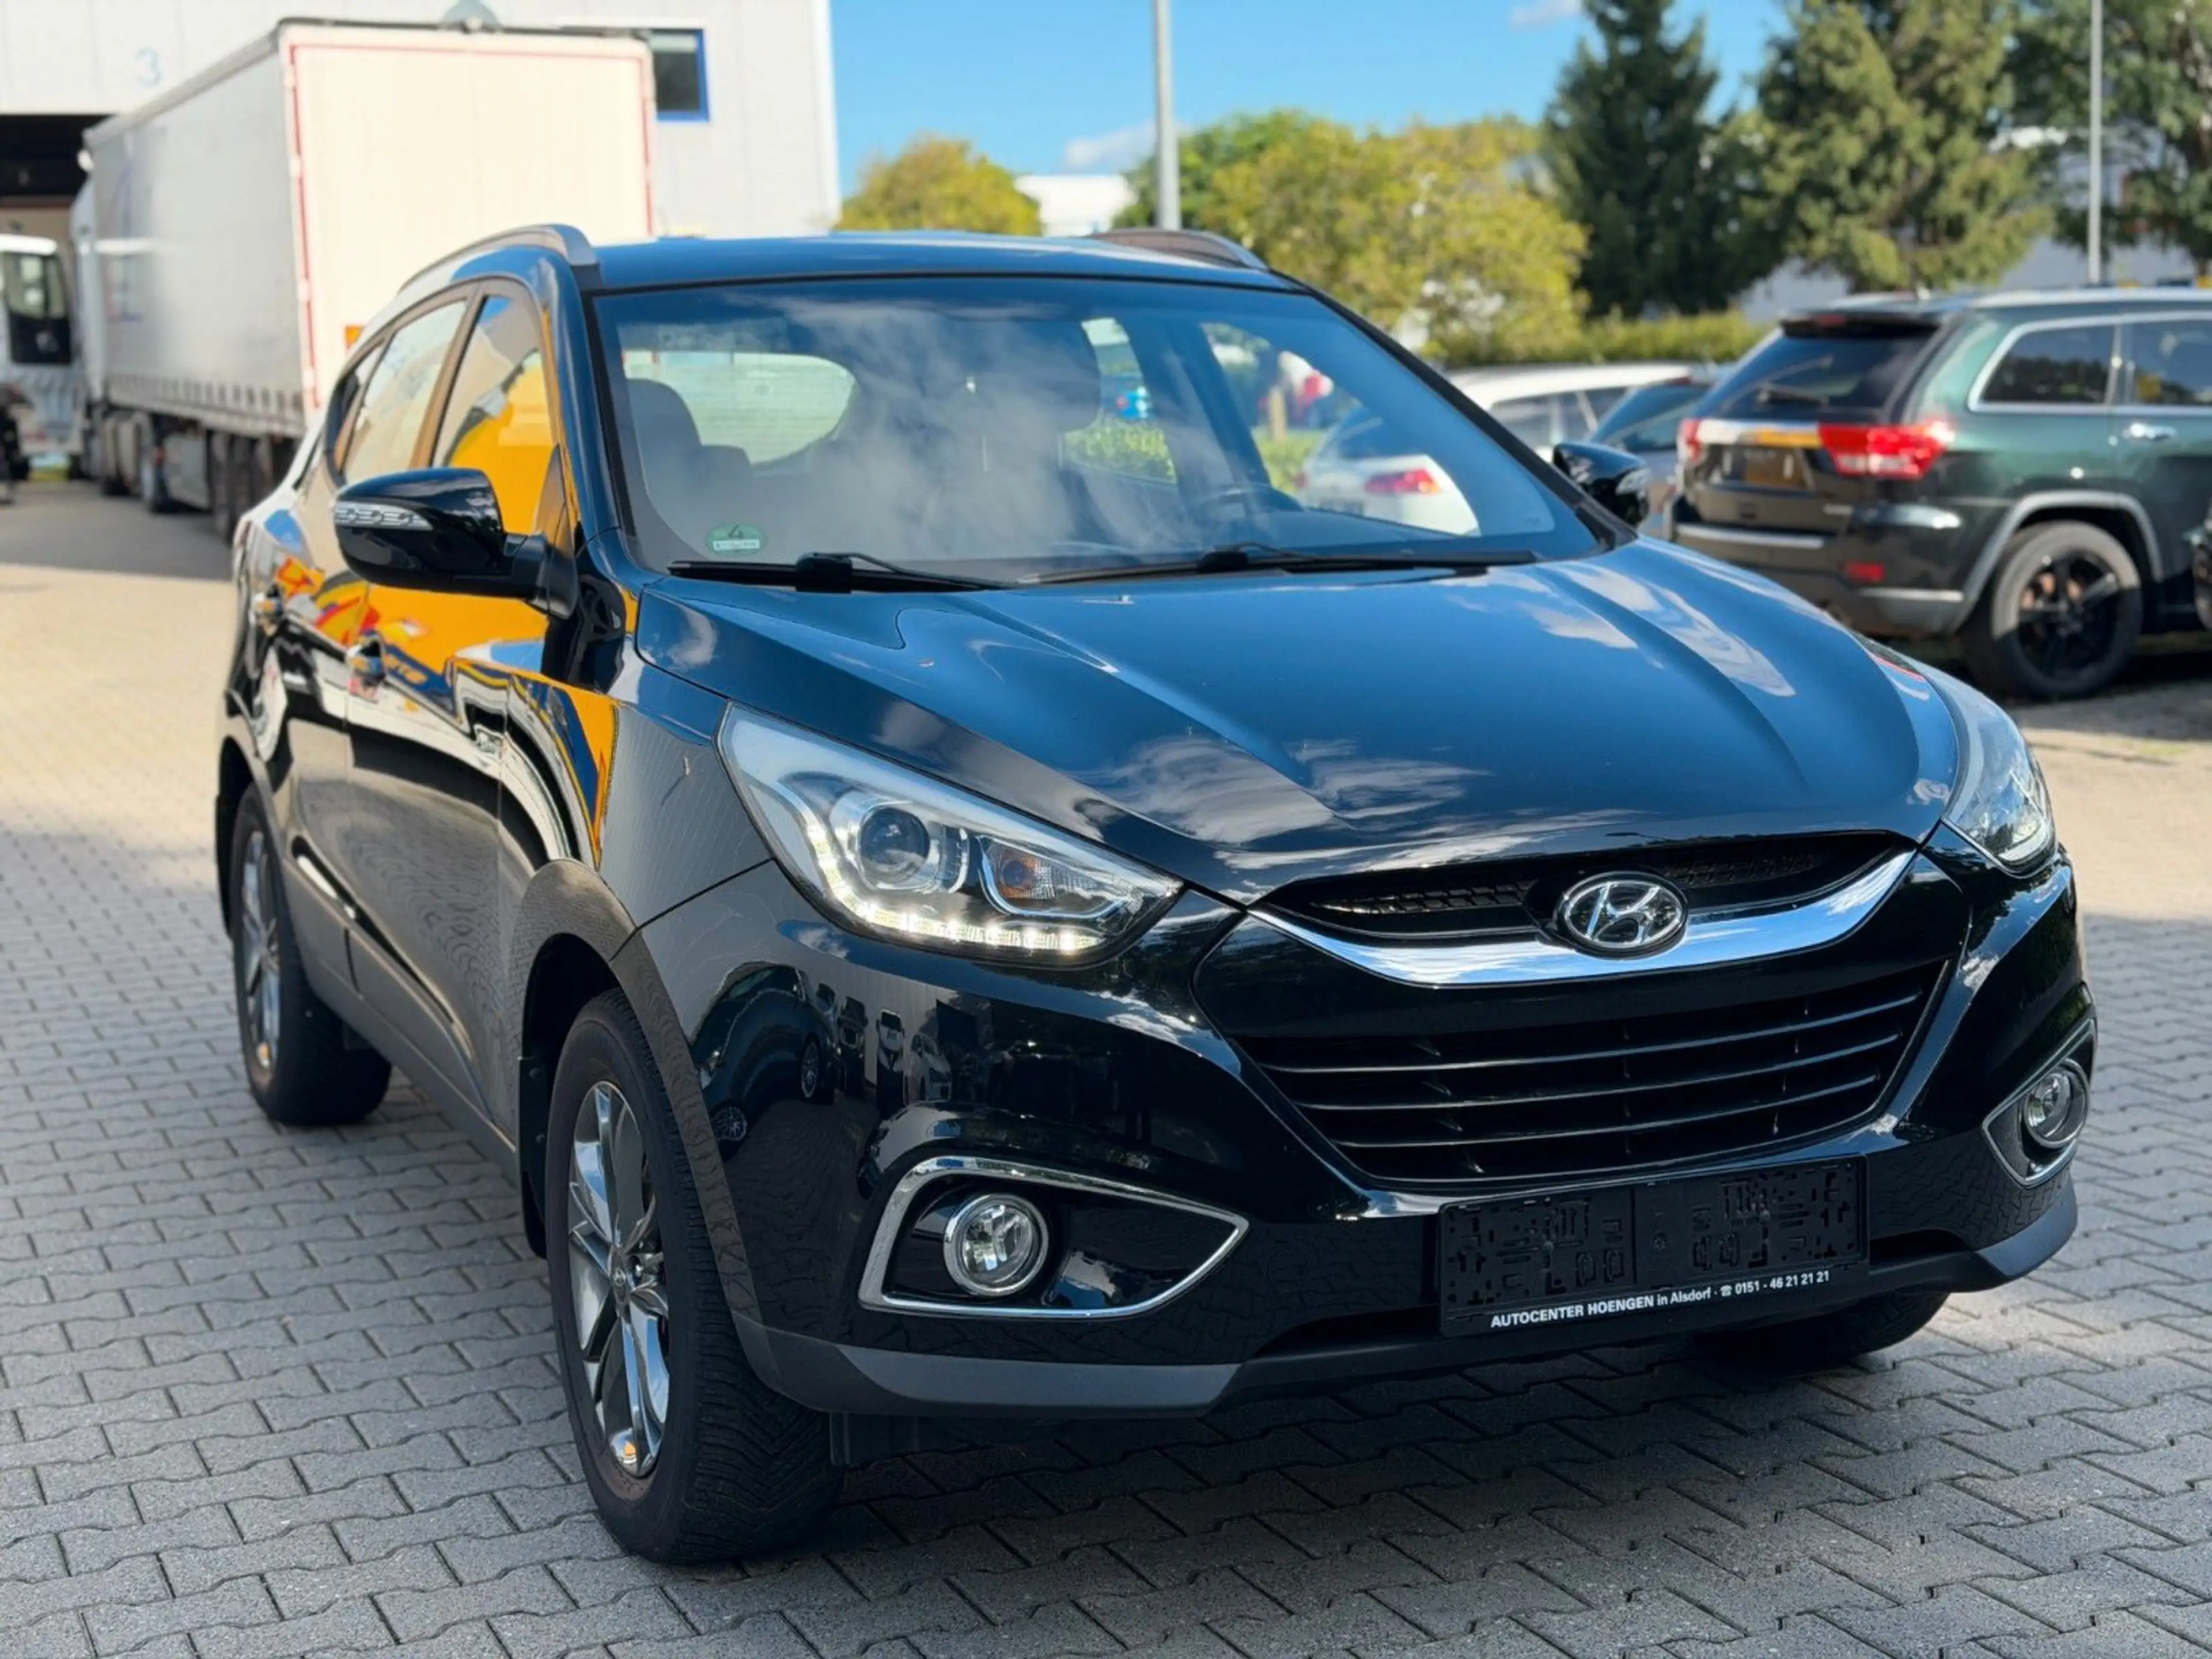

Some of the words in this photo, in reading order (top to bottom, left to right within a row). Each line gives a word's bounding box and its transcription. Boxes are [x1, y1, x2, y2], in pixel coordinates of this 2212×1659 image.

[135, 47, 162, 88] 3
[728, 522, 744, 540] 4
[1490, 1304, 1584, 1328] AUTOCENTER
[1587, 1294, 1654, 1315] HOENGEN
[1657, 1293, 1668, 1306] in
[1669, 1286, 1711, 1304] Alsdorf
[1734, 1280, 1760, 1295] 0151
[1769, 1277, 1784, 1289] 46
[1785, 1274, 1798, 1287] 21
[1801, 1272, 1813, 1285] 21
[1816, 1270, 1829, 1283] 21
